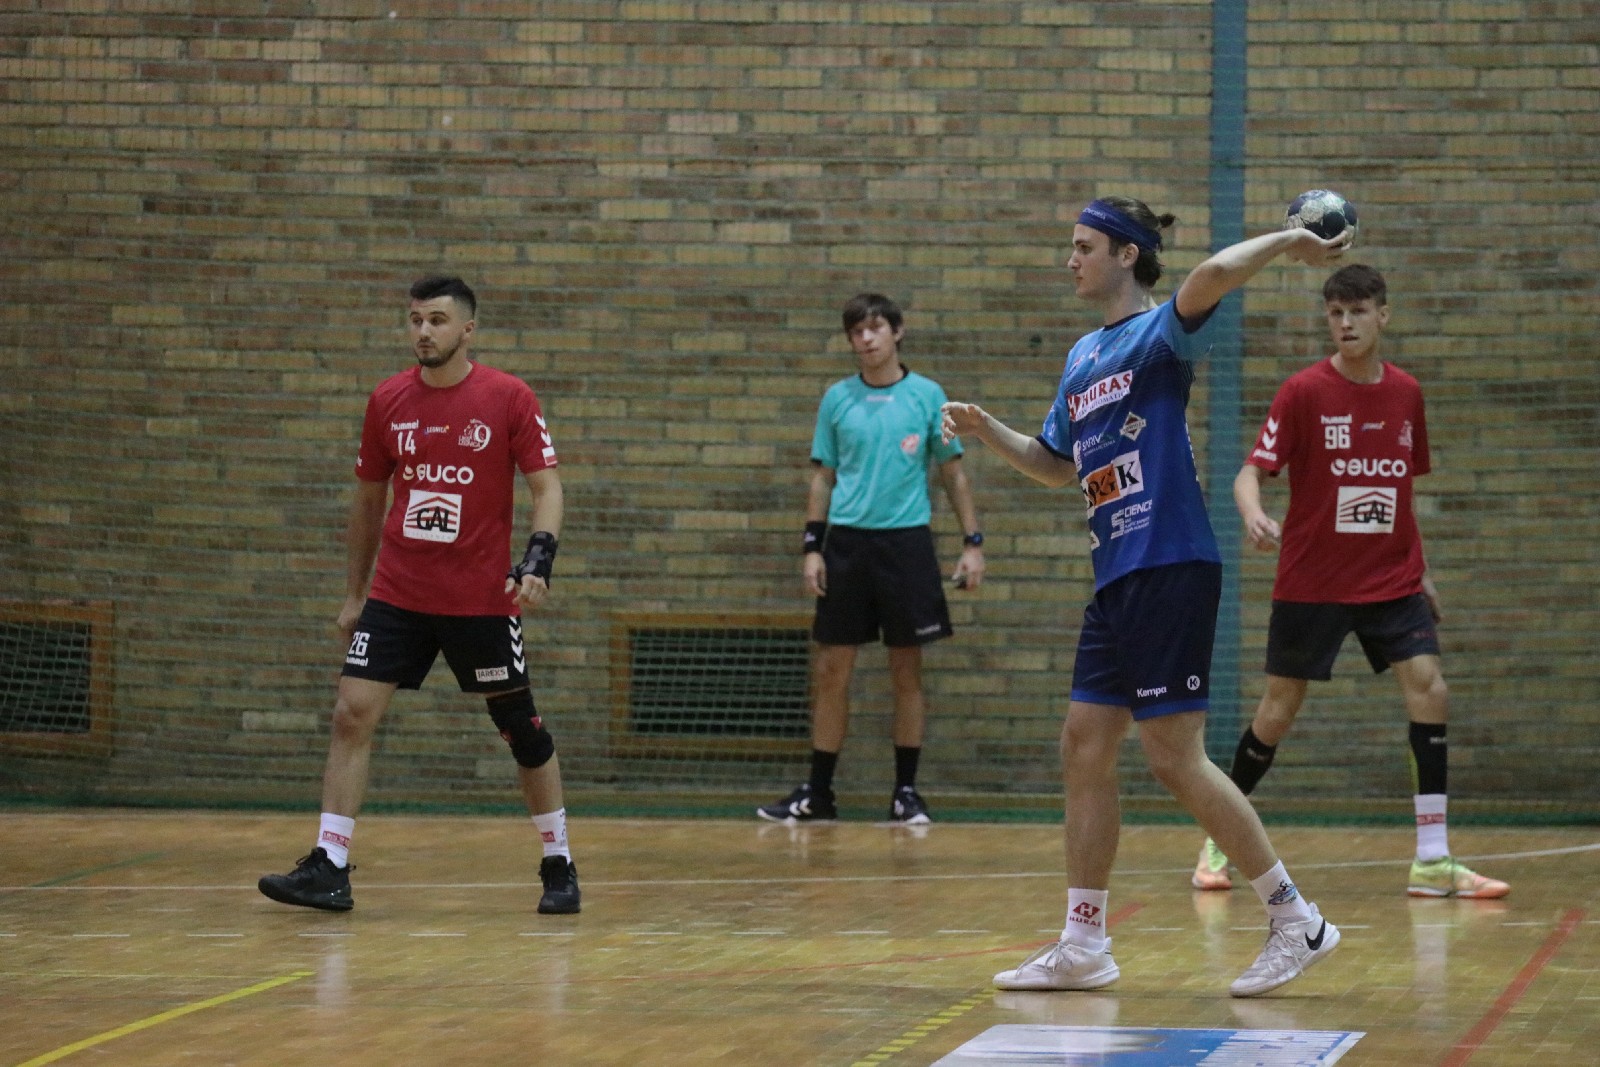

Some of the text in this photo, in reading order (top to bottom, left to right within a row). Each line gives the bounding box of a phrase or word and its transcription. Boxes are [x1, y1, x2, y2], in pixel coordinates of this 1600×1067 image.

[1081, 373, 1131, 408] HURAS
[391, 419, 419, 431] hummel
[1324, 425, 1350, 450] 96
[397, 430, 416, 455] 14
[416, 506, 457, 533] GAL
[1353, 500, 1391, 524] GAL
[348, 631, 371, 656] 26
[346, 656, 369, 667] ummel
[1136, 686, 1168, 698] Kempa
